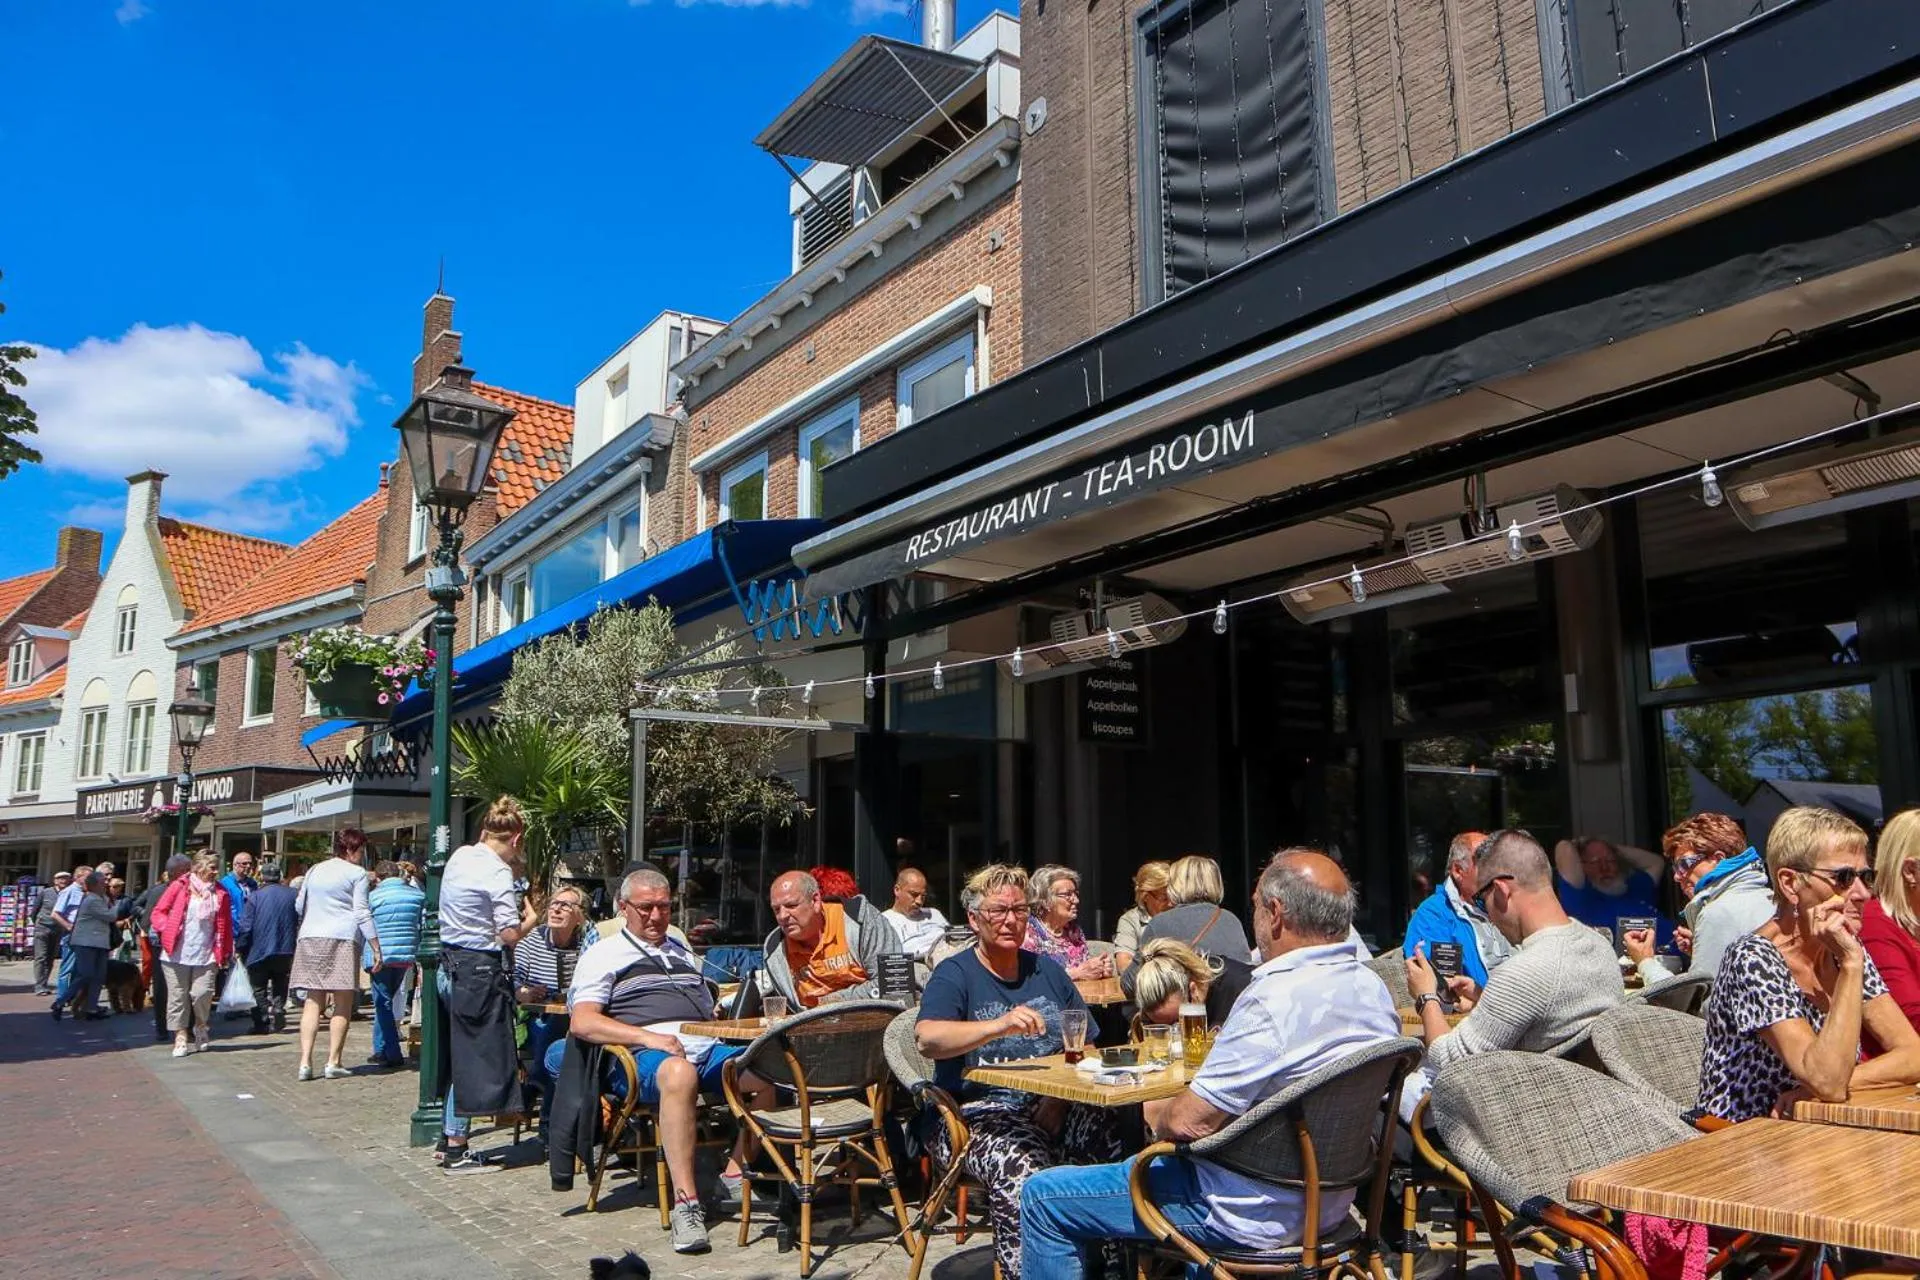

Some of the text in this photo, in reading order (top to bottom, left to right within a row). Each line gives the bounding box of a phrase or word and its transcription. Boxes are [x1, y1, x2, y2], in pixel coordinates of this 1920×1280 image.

[904, 481, 1060, 563] RESTAURANT
[1083, 409, 1255, 501] TEA-ROOM
[85, 776, 234, 815] PARFUMERIE HLYWOOD
